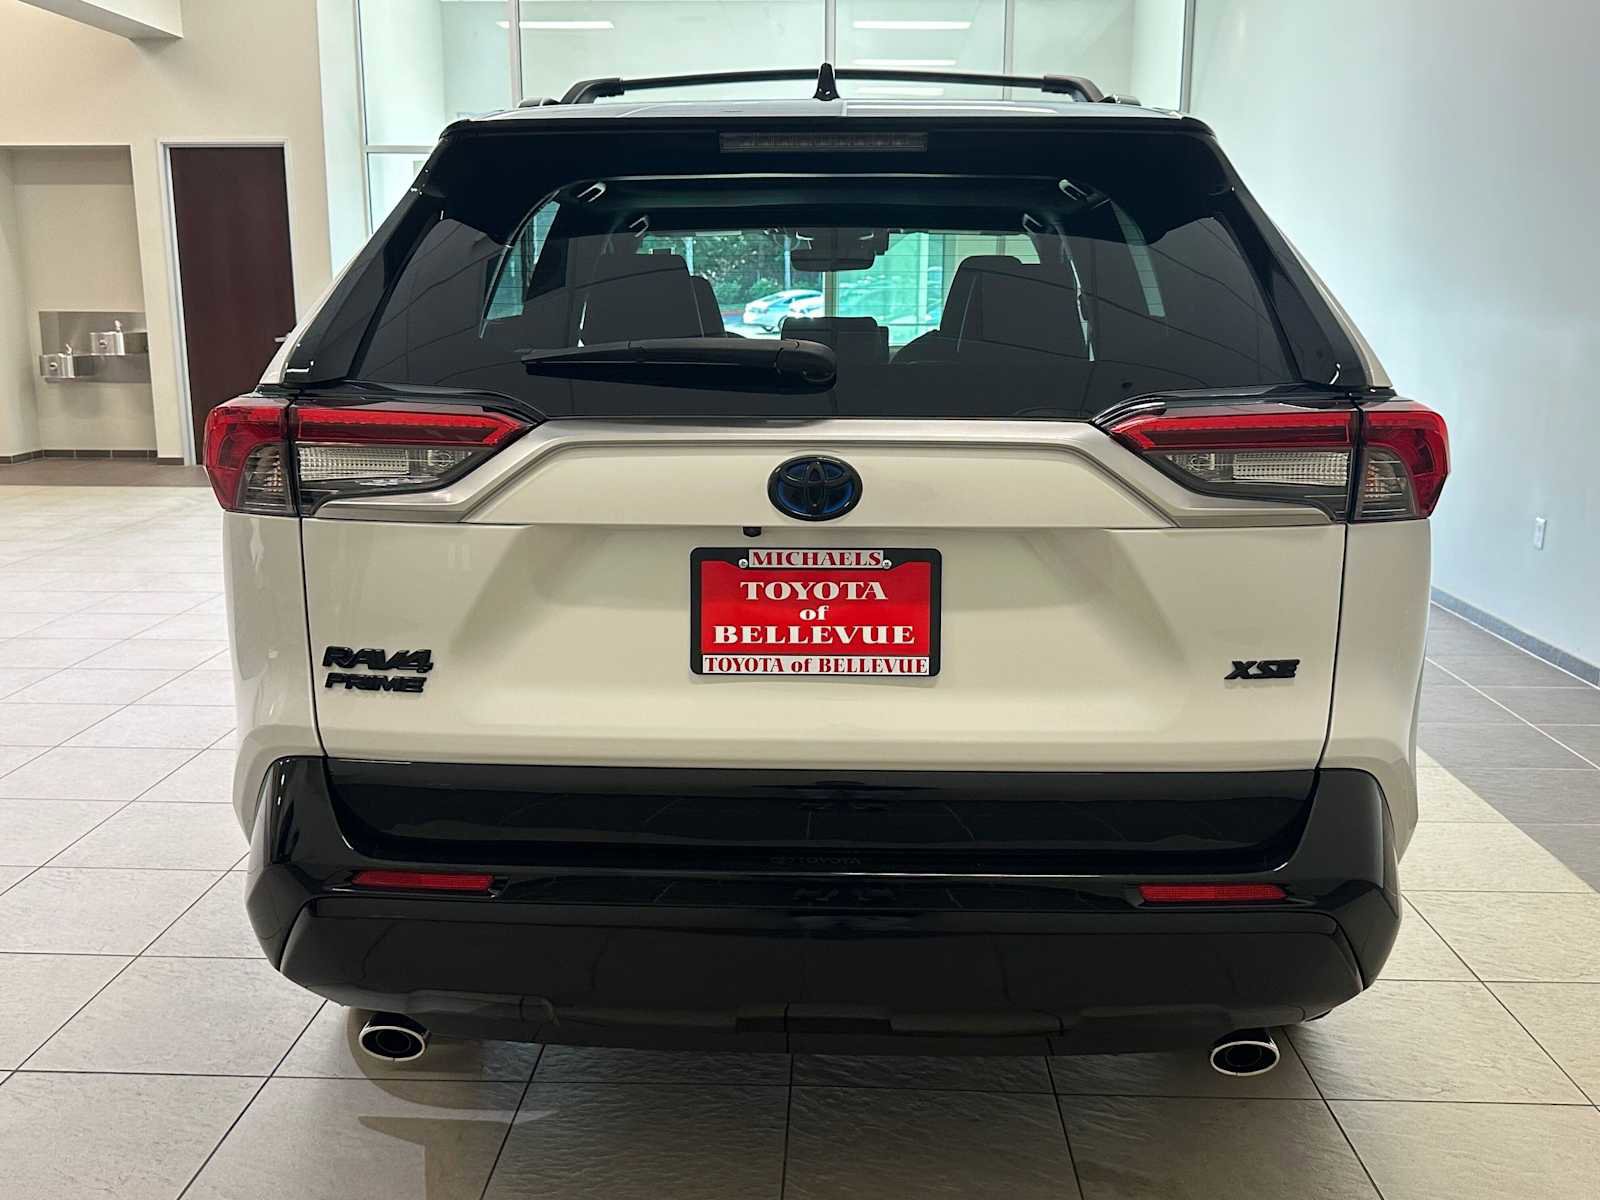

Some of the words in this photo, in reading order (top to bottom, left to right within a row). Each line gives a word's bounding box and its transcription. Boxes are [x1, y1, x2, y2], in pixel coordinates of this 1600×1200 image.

[752, 551, 881, 566] MICHAELS
[740, 581, 888, 600] TOYOTA
[799, 605, 830, 621] of
[712, 625, 915, 644] BELLEVUE
[322, 646, 433, 673] RAV4
[704, 657, 784, 673] TOYOTA
[791, 657, 813, 673] of
[819, 658, 928, 674] BELLEVUE
[1224, 659, 1300, 680] XSE
[325, 672, 427, 693] PRIME
